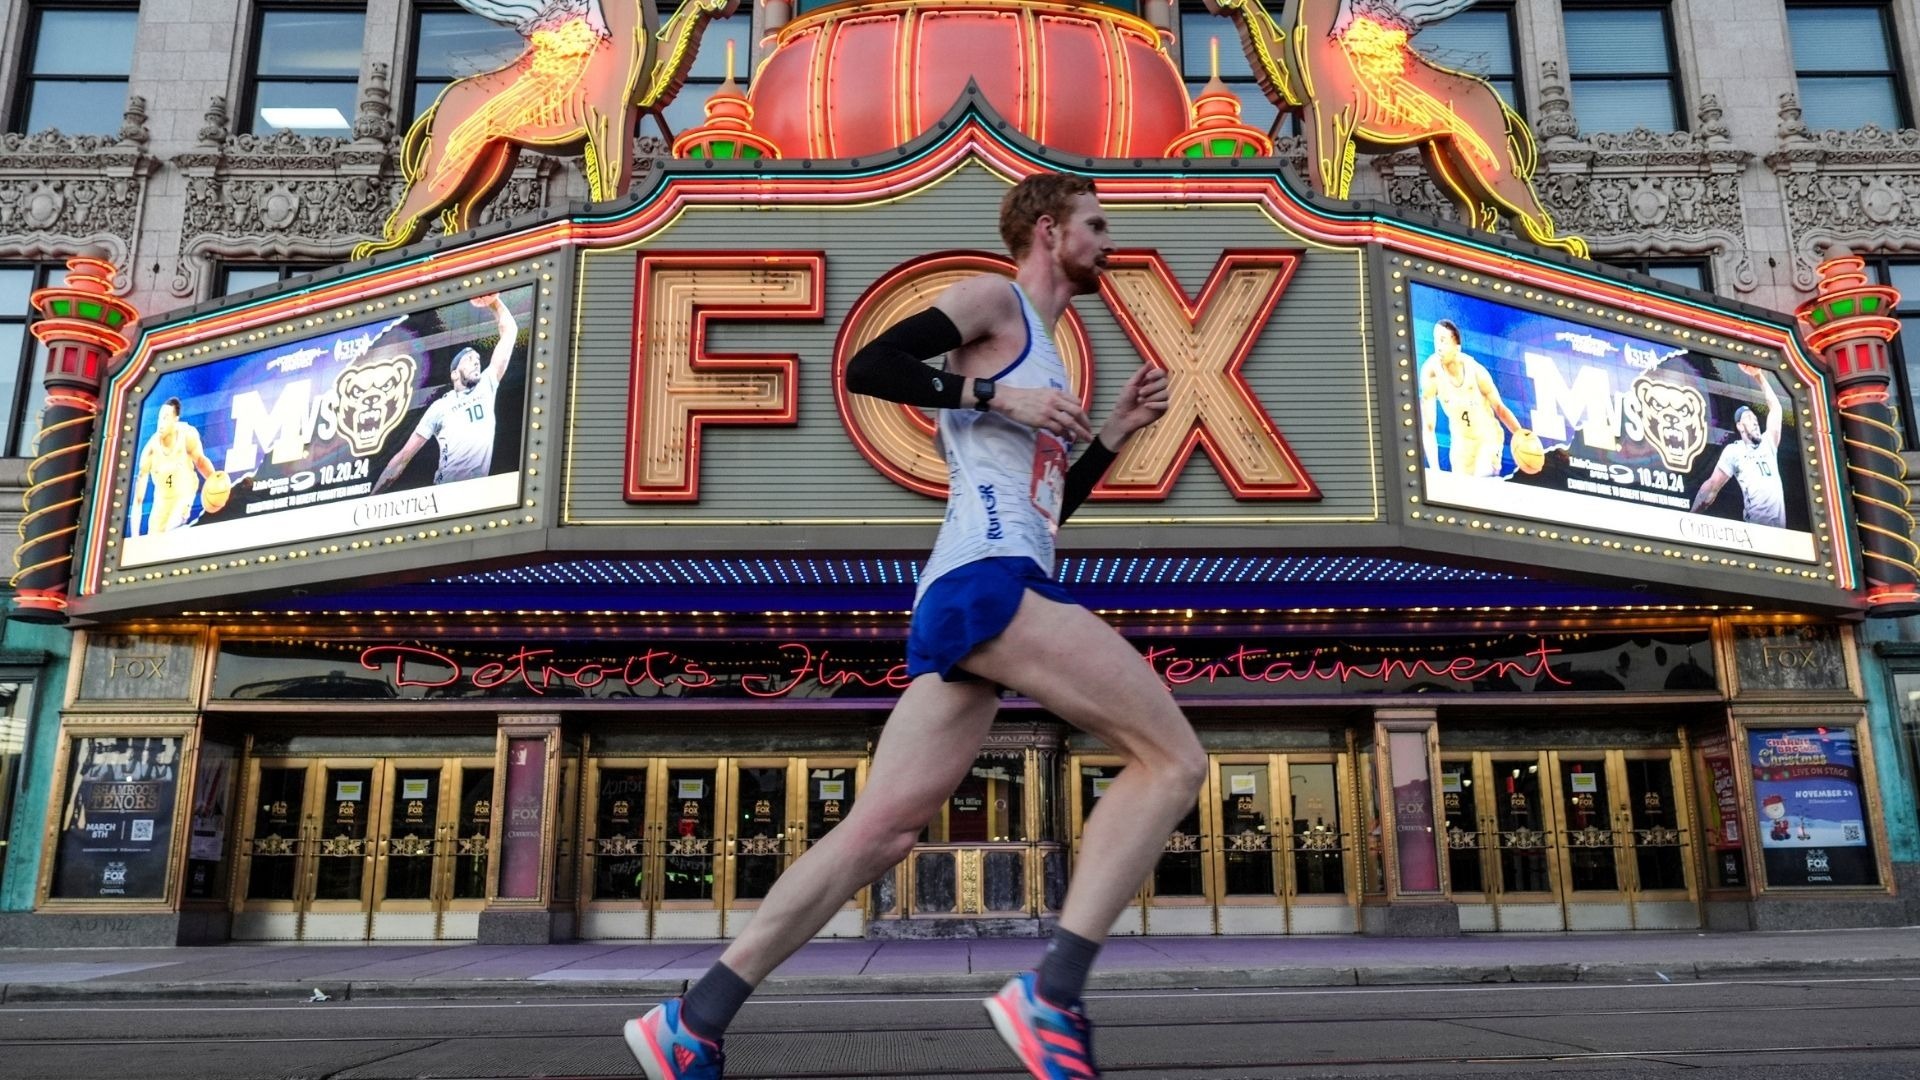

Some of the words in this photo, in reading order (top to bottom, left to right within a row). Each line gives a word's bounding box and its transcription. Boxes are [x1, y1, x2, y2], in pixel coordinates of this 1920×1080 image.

[623, 249, 1322, 500] FOX
[1525, 352, 1616, 451] M
[466, 403, 484, 422] 10
[1462, 411, 1470, 427] 4
[225, 379, 312, 473] M
[320, 458, 369, 485] 10.20.24
[1756, 461, 1771, 476] 10
[165, 474, 173, 488] 4
[1637, 467, 1684, 493] 10.20.24
[1762, 645, 1817, 669] FOX
[110, 656, 167, 680] FOX
[360, 645, 717, 695] Detroit's
[1759, 748, 1827, 768] Christmas
[1792, 768, 1809, 776] LIVE
[1810, 767, 1823, 775] ON
[1825, 767, 1849, 776] STAGE
[94, 784, 156, 795] SHAMROCK
[1795, 790, 1842, 798] NOVEMBER
[92, 796, 157, 809] TENORS
[1398, 803, 1424, 814] FOX
[511, 809, 538, 820] FOX
[86, 823, 116, 831] MARCH
[1807, 859, 1828, 868] FOX
[104, 872, 125, 880] FOX
